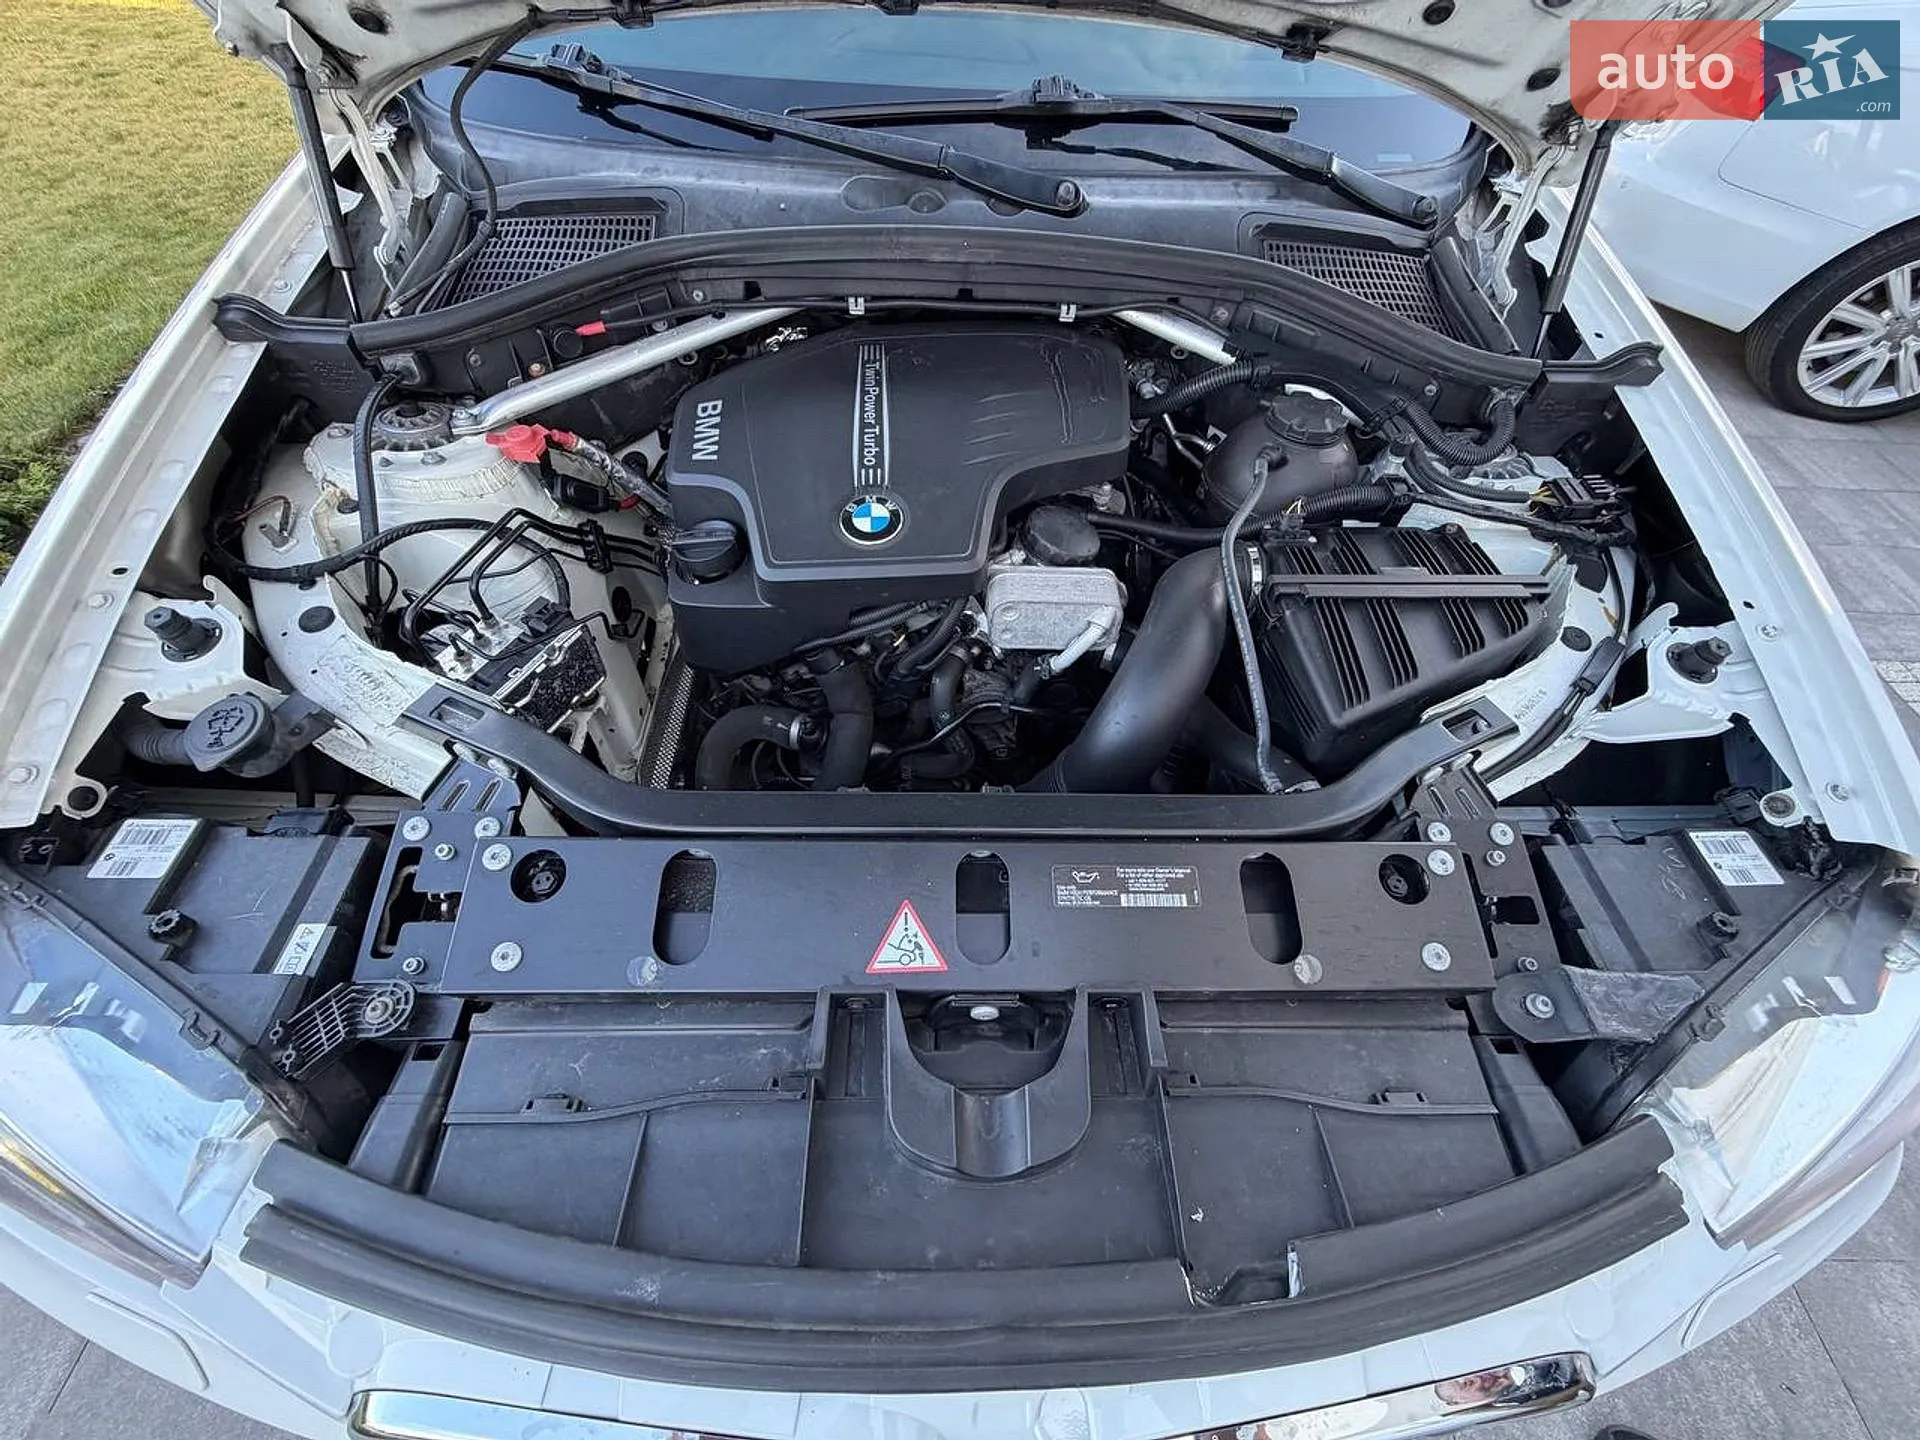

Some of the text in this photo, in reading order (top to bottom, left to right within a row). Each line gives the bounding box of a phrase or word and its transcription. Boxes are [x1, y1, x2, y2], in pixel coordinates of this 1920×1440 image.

[691, 399, 723, 461] BMW
[863, 361, 881, 466] TwinPower Turbo
[845, 494, 898, 513] BMW
